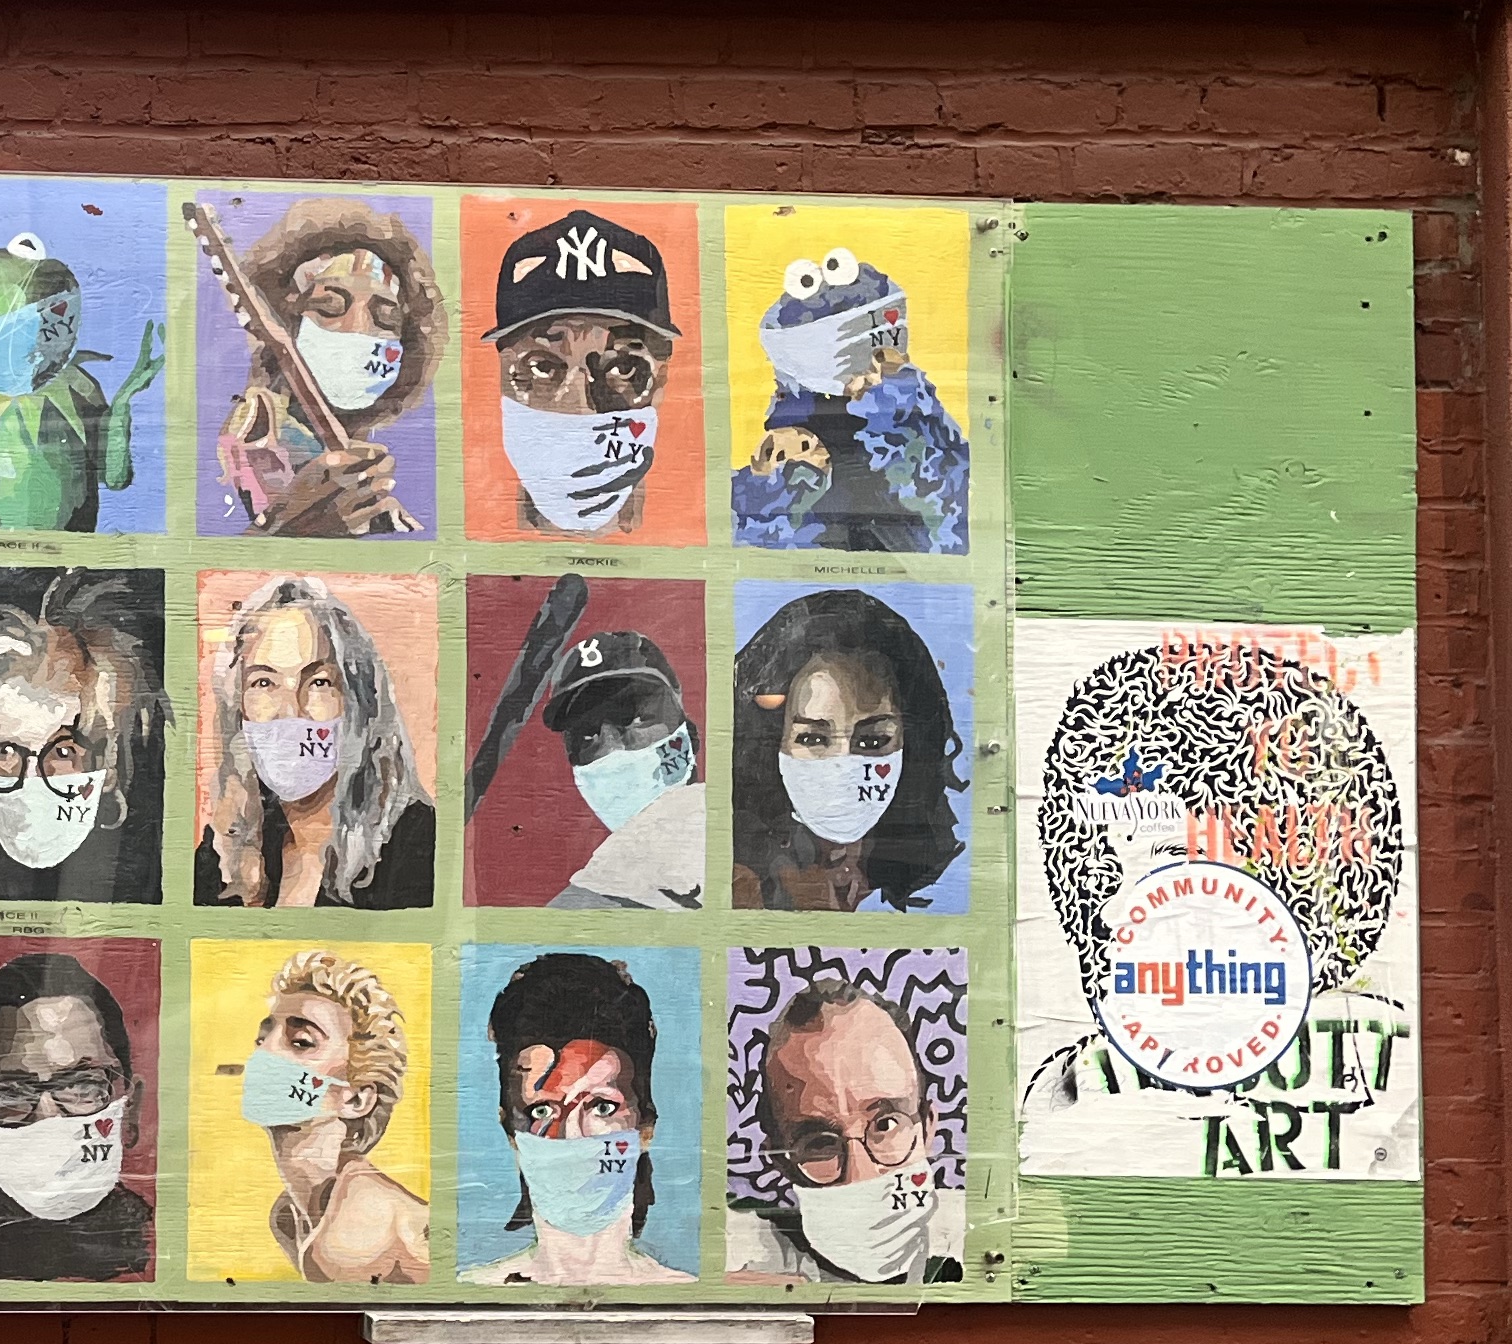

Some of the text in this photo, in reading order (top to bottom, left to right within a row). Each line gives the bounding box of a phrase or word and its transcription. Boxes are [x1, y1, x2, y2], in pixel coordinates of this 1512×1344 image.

[556, 226, 607, 280] NY
[868, 310, 879, 328] I
[40, 315, 75, 342] NY
[869, 327, 901, 347] NY
[371, 342, 382, 356] I
[364, 360, 395, 378] NY
[610, 416, 622, 436] I
[604, 440, 643, 463] NY
[568, 557, 619, 567] JACKIE
[814, 565, 887, 575] MICHELLE
[306, 728, 313, 741] I
[299, 742, 334, 758] NY
[660, 743, 671, 759] I
[661, 749, 691, 775] NY
[862, 763, 873, 781] I
[858, 784, 891, 802] NY
[56, 805, 92, 823] NY
[1076, 797, 1182, 821] NUEVA YORK
[1139, 823, 1176, 834] coffee
[1116, 877, 1288, 945] COMMUNITY
[12, 926, 45, 935] RBG
[1114, 949, 1287, 1006] anything
[1122, 1020, 1281, 1074] APROVED
[298, 1071, 309, 1085] I
[288, 1085, 320, 1107] NY
[83, 1123, 93, 1139] I
[1202, 1100, 1348, 1176] ART
[80, 1144, 114, 1163] NY
[603, 1140, 612, 1156] I
[599, 1159, 627, 1174] NY
[894, 1173, 904, 1191] I
[891, 1190, 928, 1210] NY
